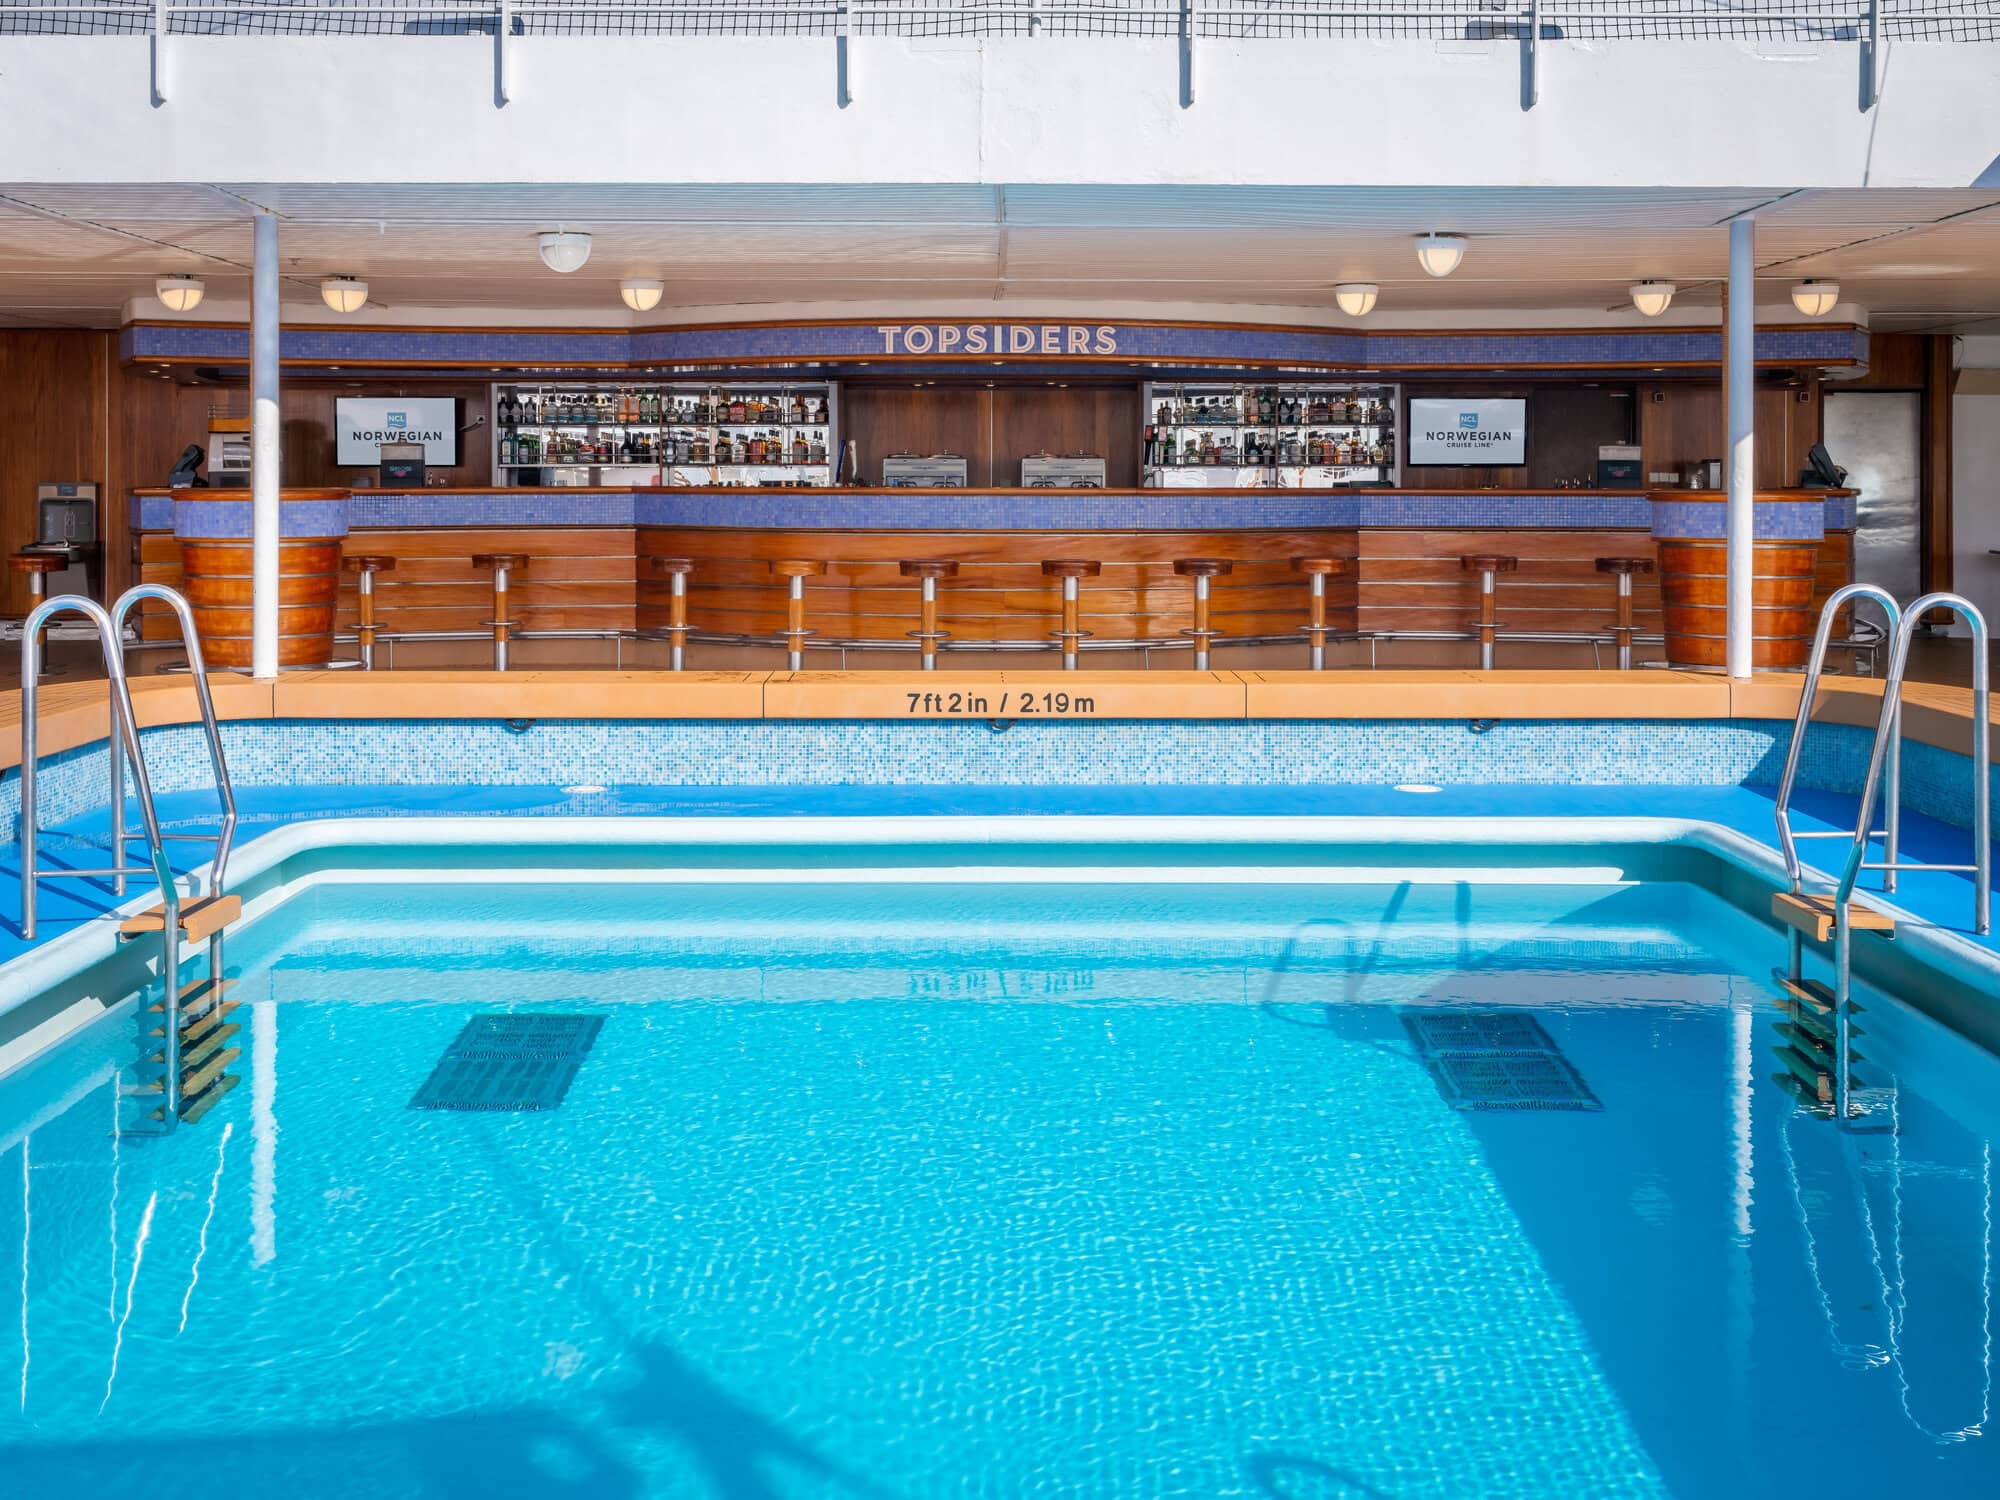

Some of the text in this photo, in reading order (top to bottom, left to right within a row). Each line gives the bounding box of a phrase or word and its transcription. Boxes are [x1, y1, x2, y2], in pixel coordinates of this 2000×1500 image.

[878, 324, 1117, 355] TOPSIDERS
[353, 431, 442, 441] NORWEGIAN
[1426, 431, 1512, 441] NORWEGIAN
